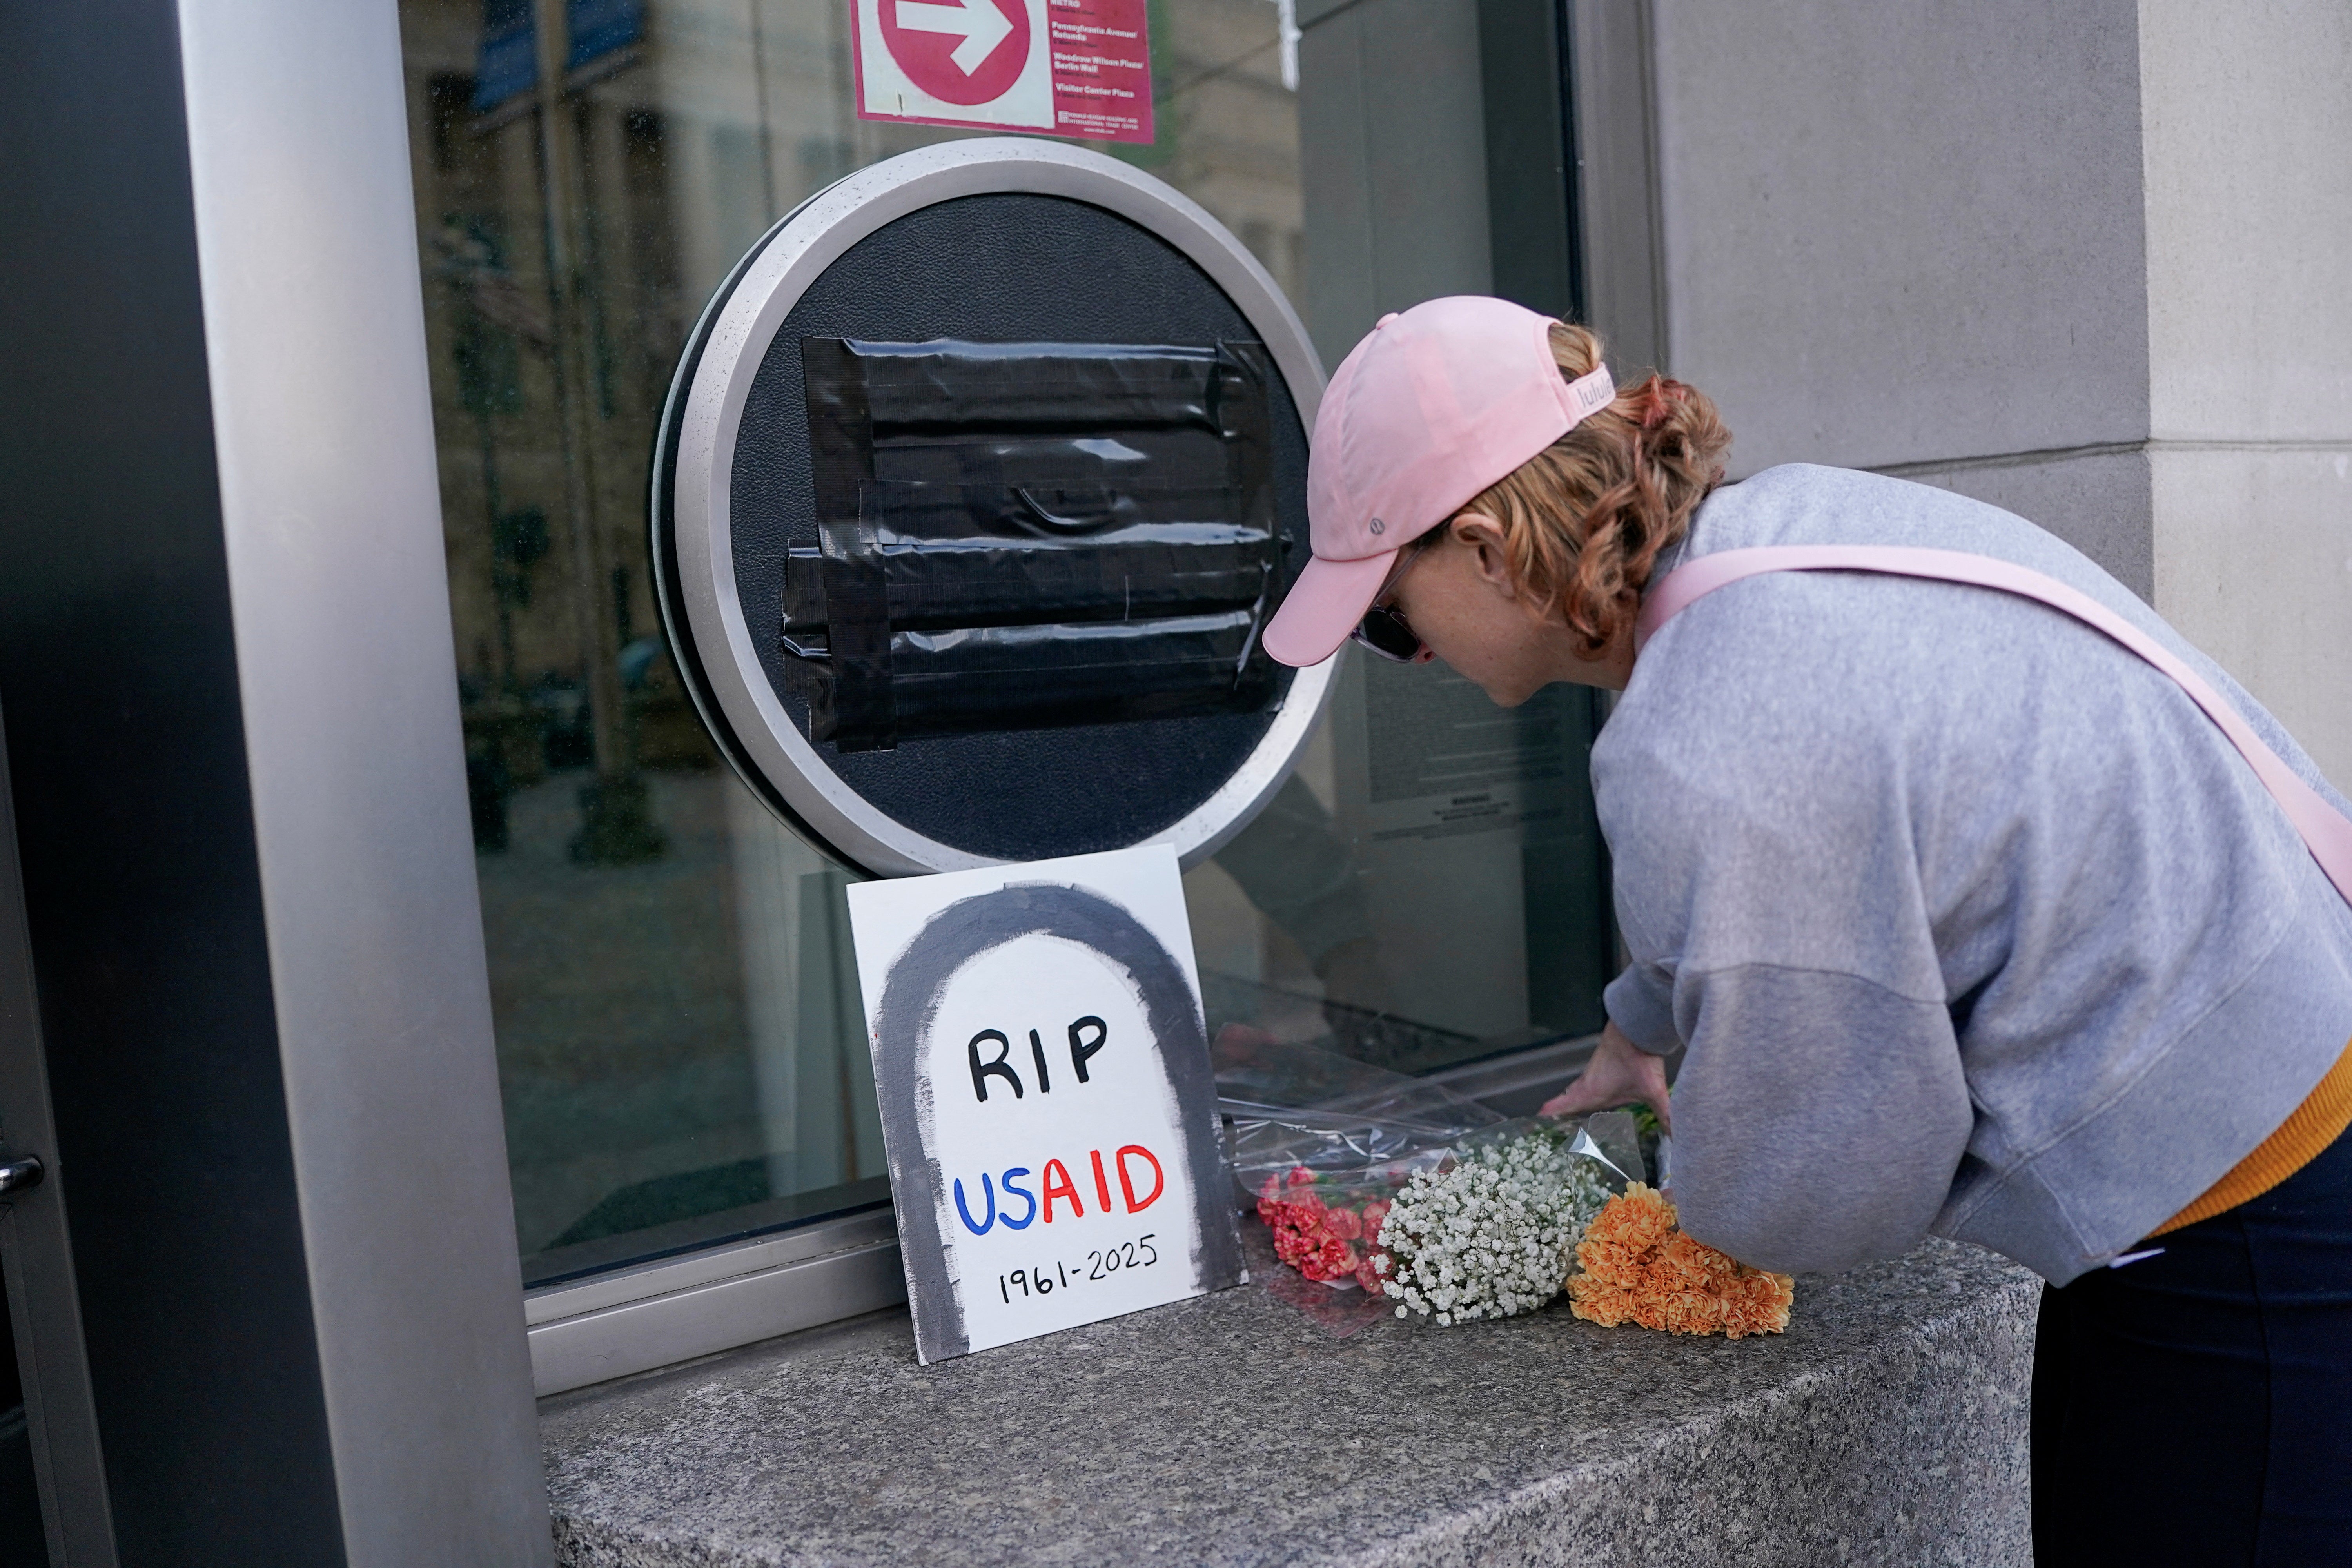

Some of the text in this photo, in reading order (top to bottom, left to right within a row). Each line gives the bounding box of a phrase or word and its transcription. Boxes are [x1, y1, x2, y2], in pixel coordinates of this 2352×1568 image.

[1052, 21, 1105, 34] Pennsylvania
[1053, 30, 1087, 41] Rotunda
[1053, 52, 1091, 63] Woodrow
[1092, 56, 1119, 66] Wilson
[1054, 61, 1098, 73] Berlin Wall
[1056, 82, 1083, 93] Visitor
[1084, 85, 1112, 96] Center
[1112, 88, 1134, 98] Plaza
[968, 1016, 1107, 1102] RIP
[954, 1145, 1164, 1236] USAID
[1000, 1234, 1158, 1303] 1961-2025
